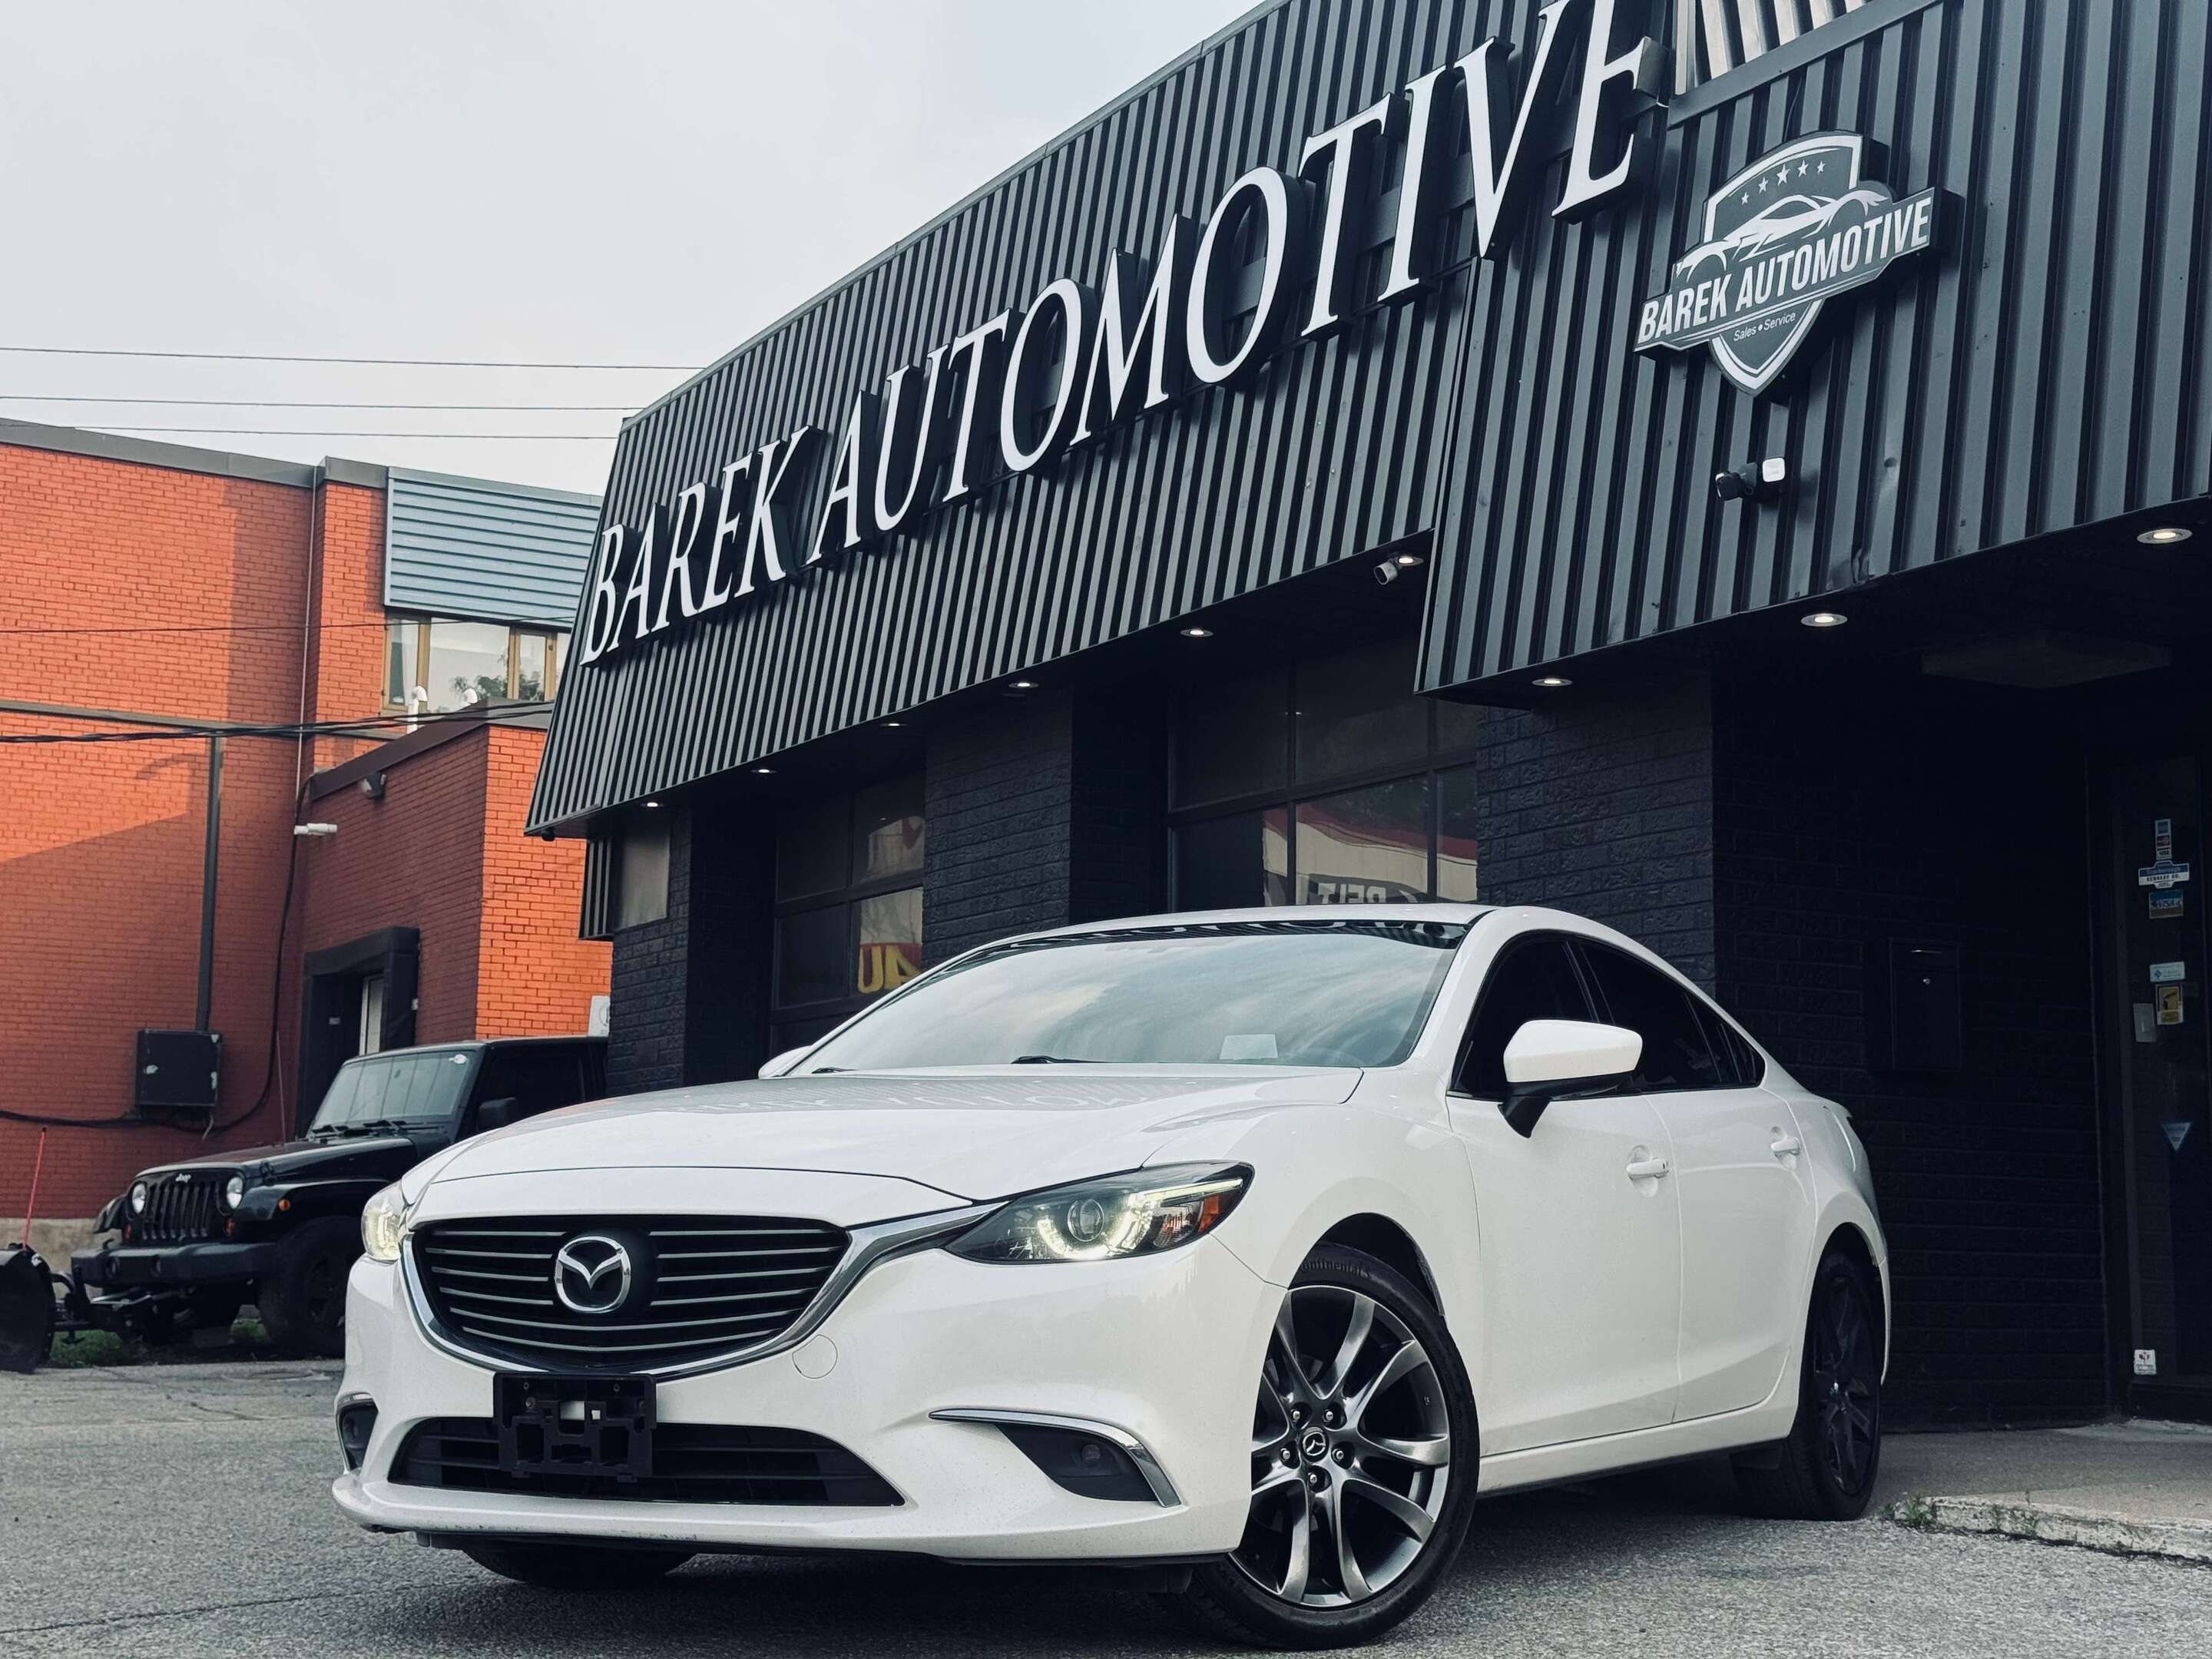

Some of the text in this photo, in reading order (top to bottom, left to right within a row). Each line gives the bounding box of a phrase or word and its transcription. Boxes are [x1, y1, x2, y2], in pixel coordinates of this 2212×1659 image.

[580, 0, 1646, 666] BAREK AUTOMOTIVE
[1637, 197, 1932, 344] BAREK AUTOMOTIVE
[1733, 313, 1796, 342] Sales Service
